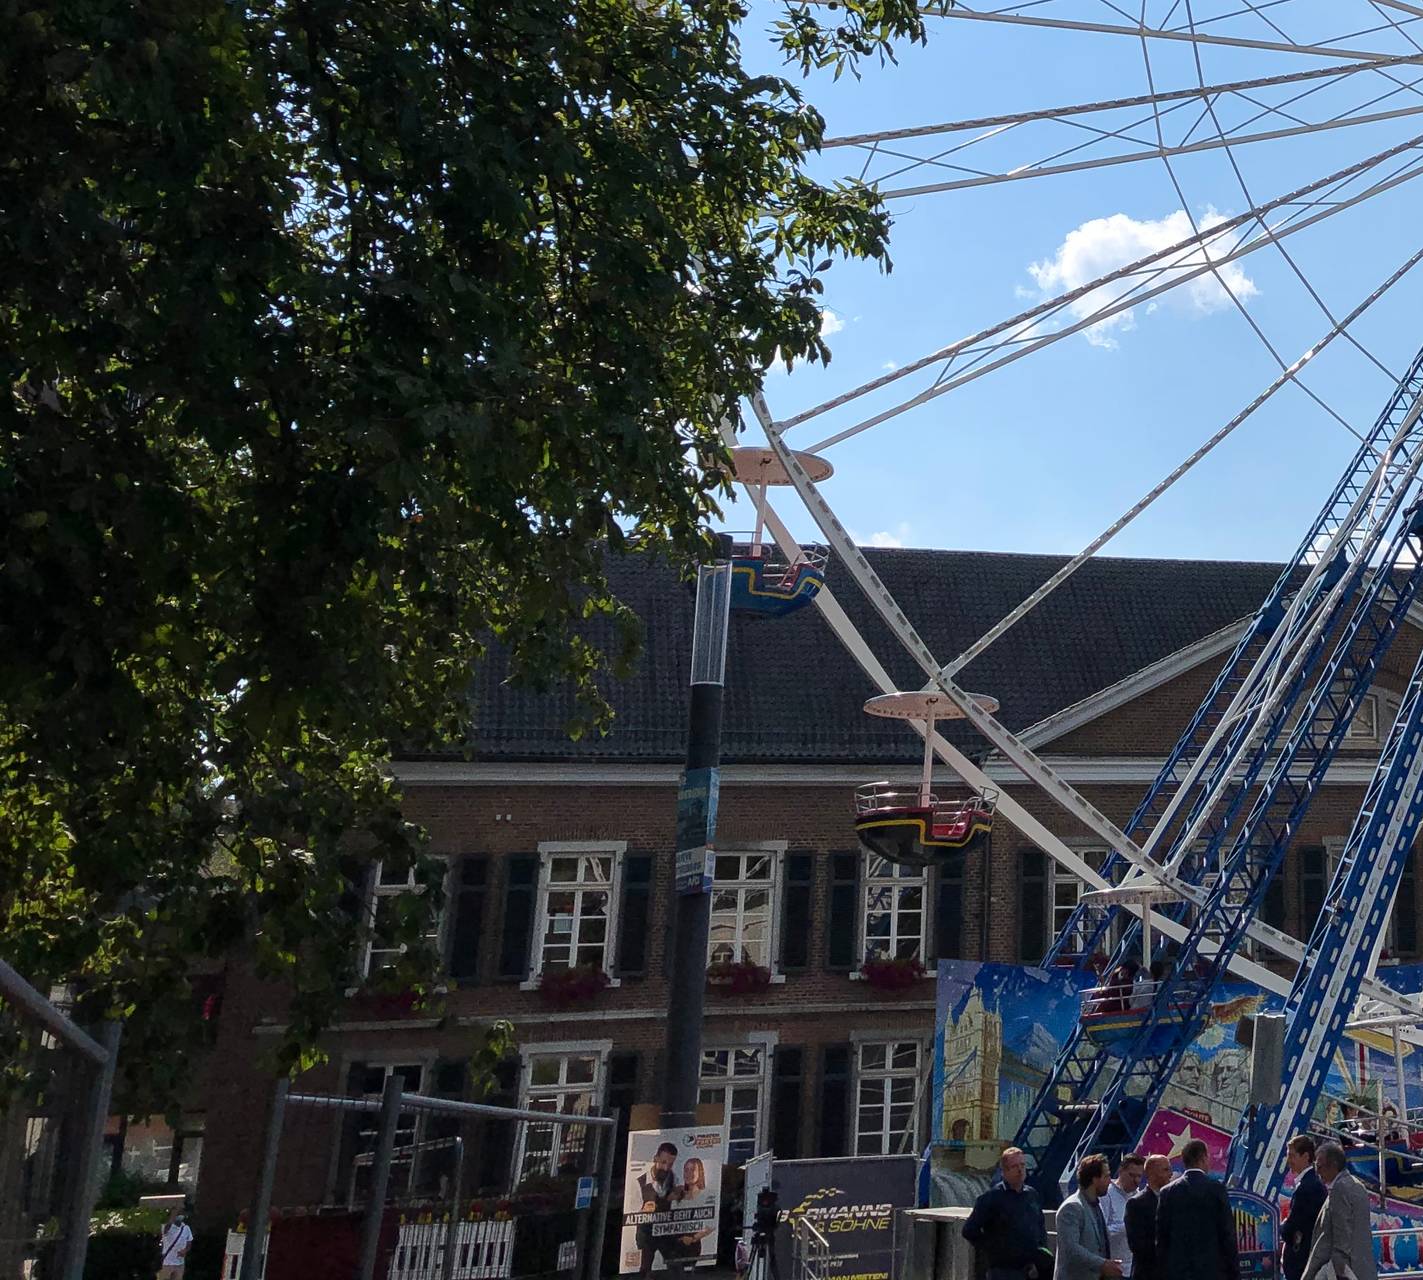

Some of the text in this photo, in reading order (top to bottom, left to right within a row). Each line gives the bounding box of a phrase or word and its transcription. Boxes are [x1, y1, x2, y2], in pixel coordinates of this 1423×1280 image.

[692, 1207, 713, 1219] AUCH
[776, 1203, 893, 1223] GRMANNS
[654, 1221, 704, 1235] SYMPATHISCH
